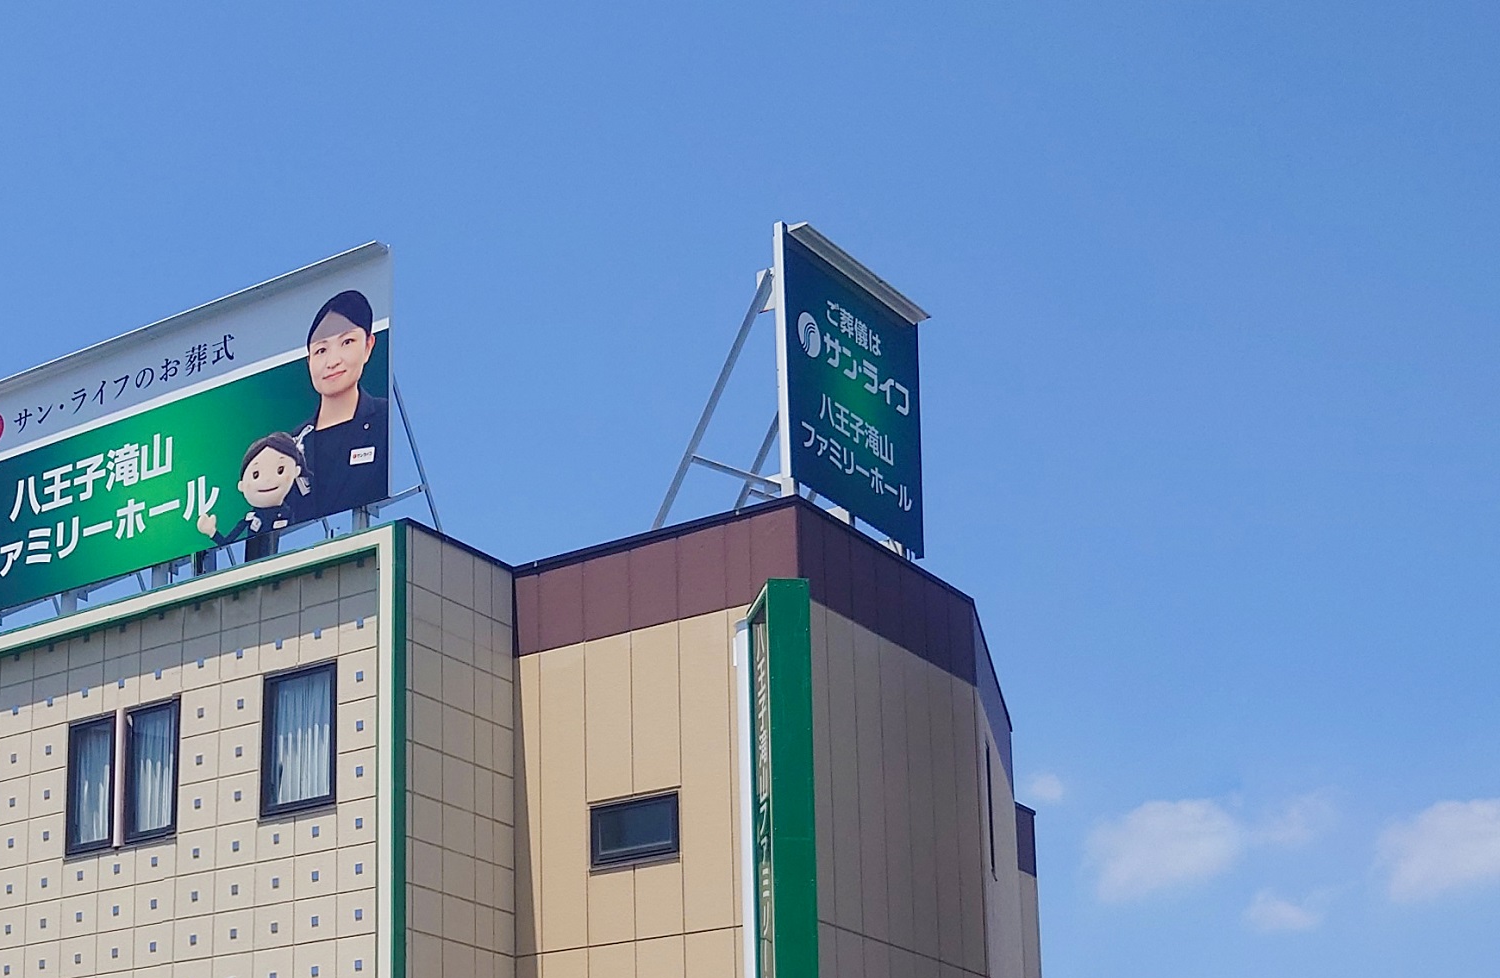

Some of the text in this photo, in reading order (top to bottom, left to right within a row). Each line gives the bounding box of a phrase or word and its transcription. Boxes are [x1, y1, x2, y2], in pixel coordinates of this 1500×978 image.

[826, 300, 882, 357] ご葬儀は
[801, 420, 913, 512] ファミリーホール
[819, 393, 895, 466] 八王子滝山
[9, 432, 173, 522] 八王子滝山
